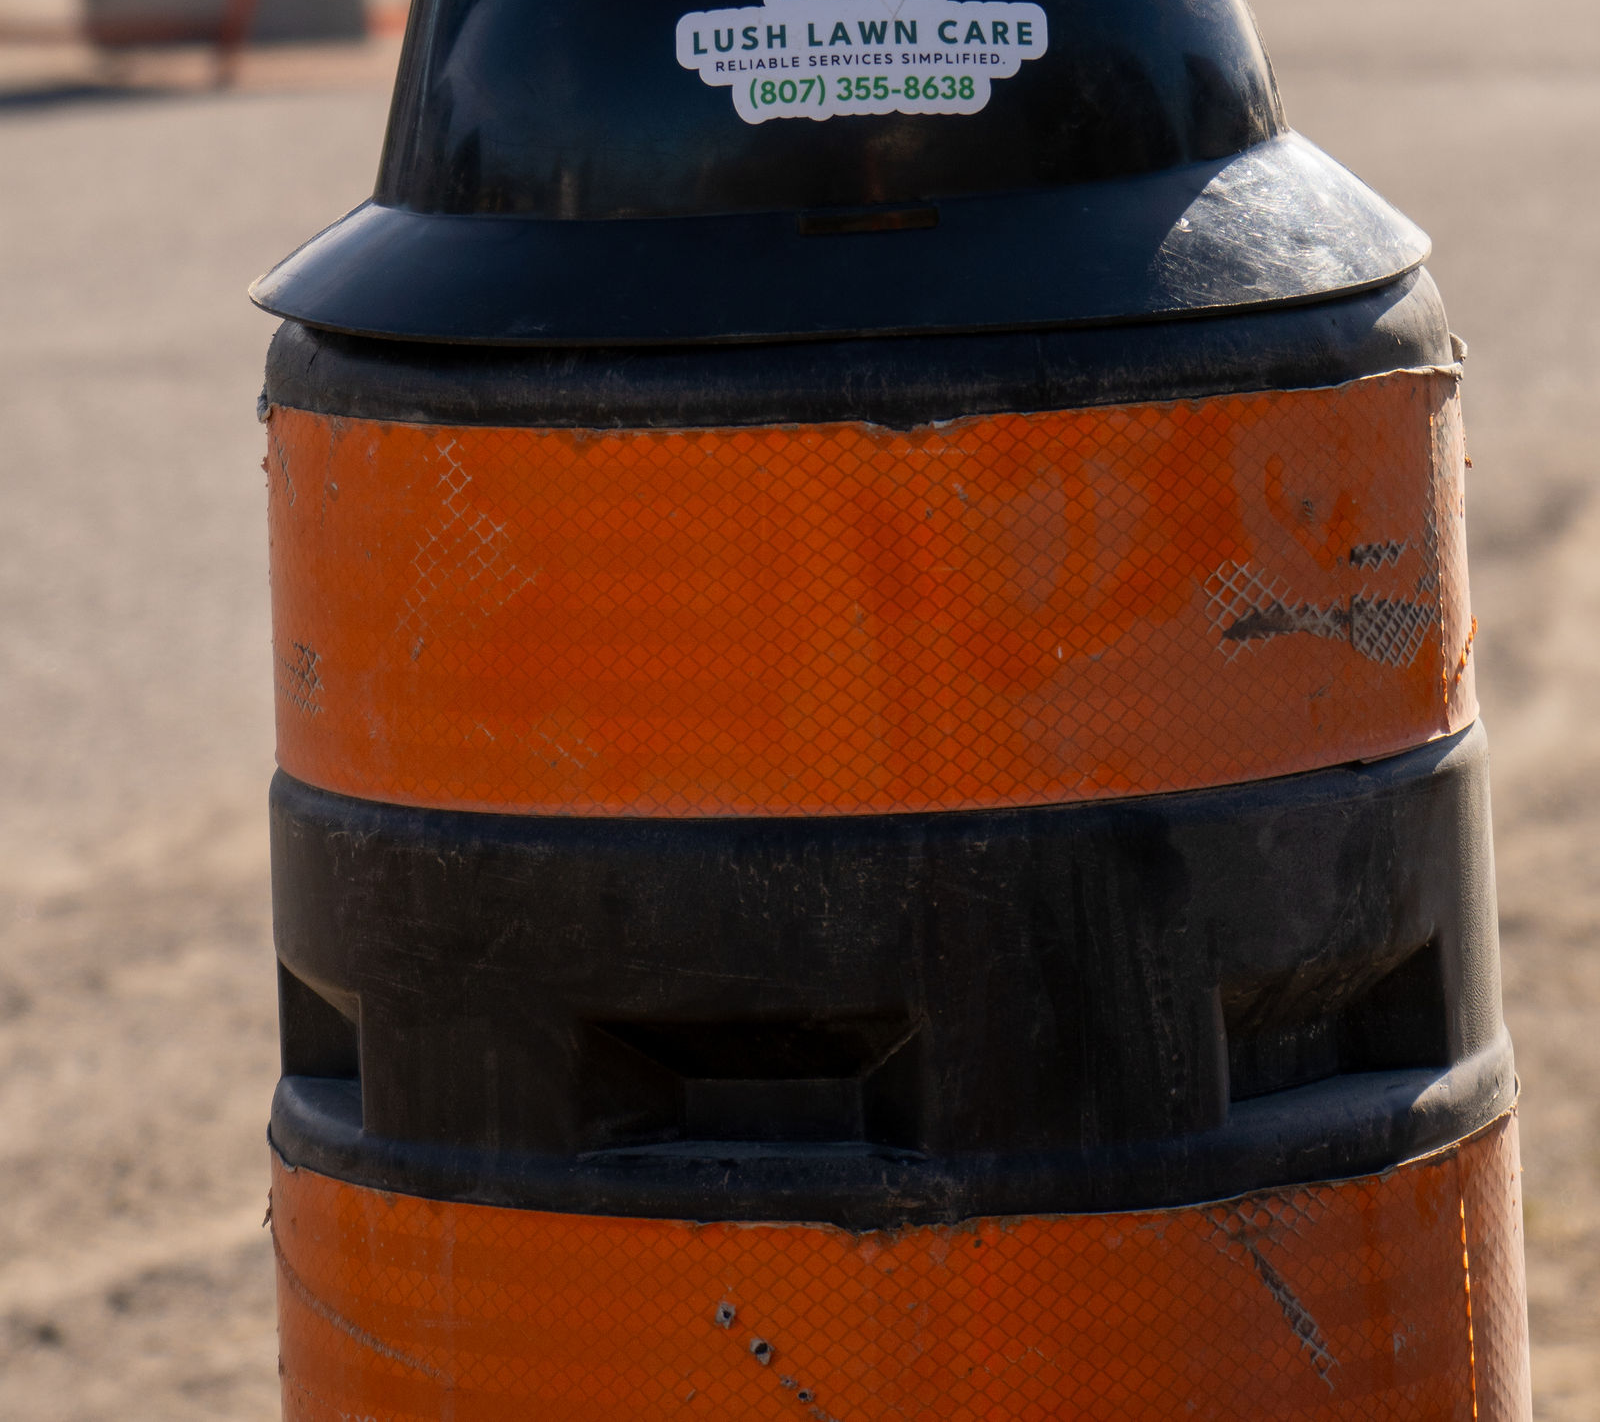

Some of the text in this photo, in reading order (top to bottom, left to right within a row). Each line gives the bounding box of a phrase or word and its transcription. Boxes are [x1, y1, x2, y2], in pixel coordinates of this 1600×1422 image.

[693, 20, 1033, 55] LUSH LAWN CARE
[715, 52, 1006, 72] RELIABLE SERVICES SIMPLIFIED.
[749, 74, 975, 110] (807) 355-8638
